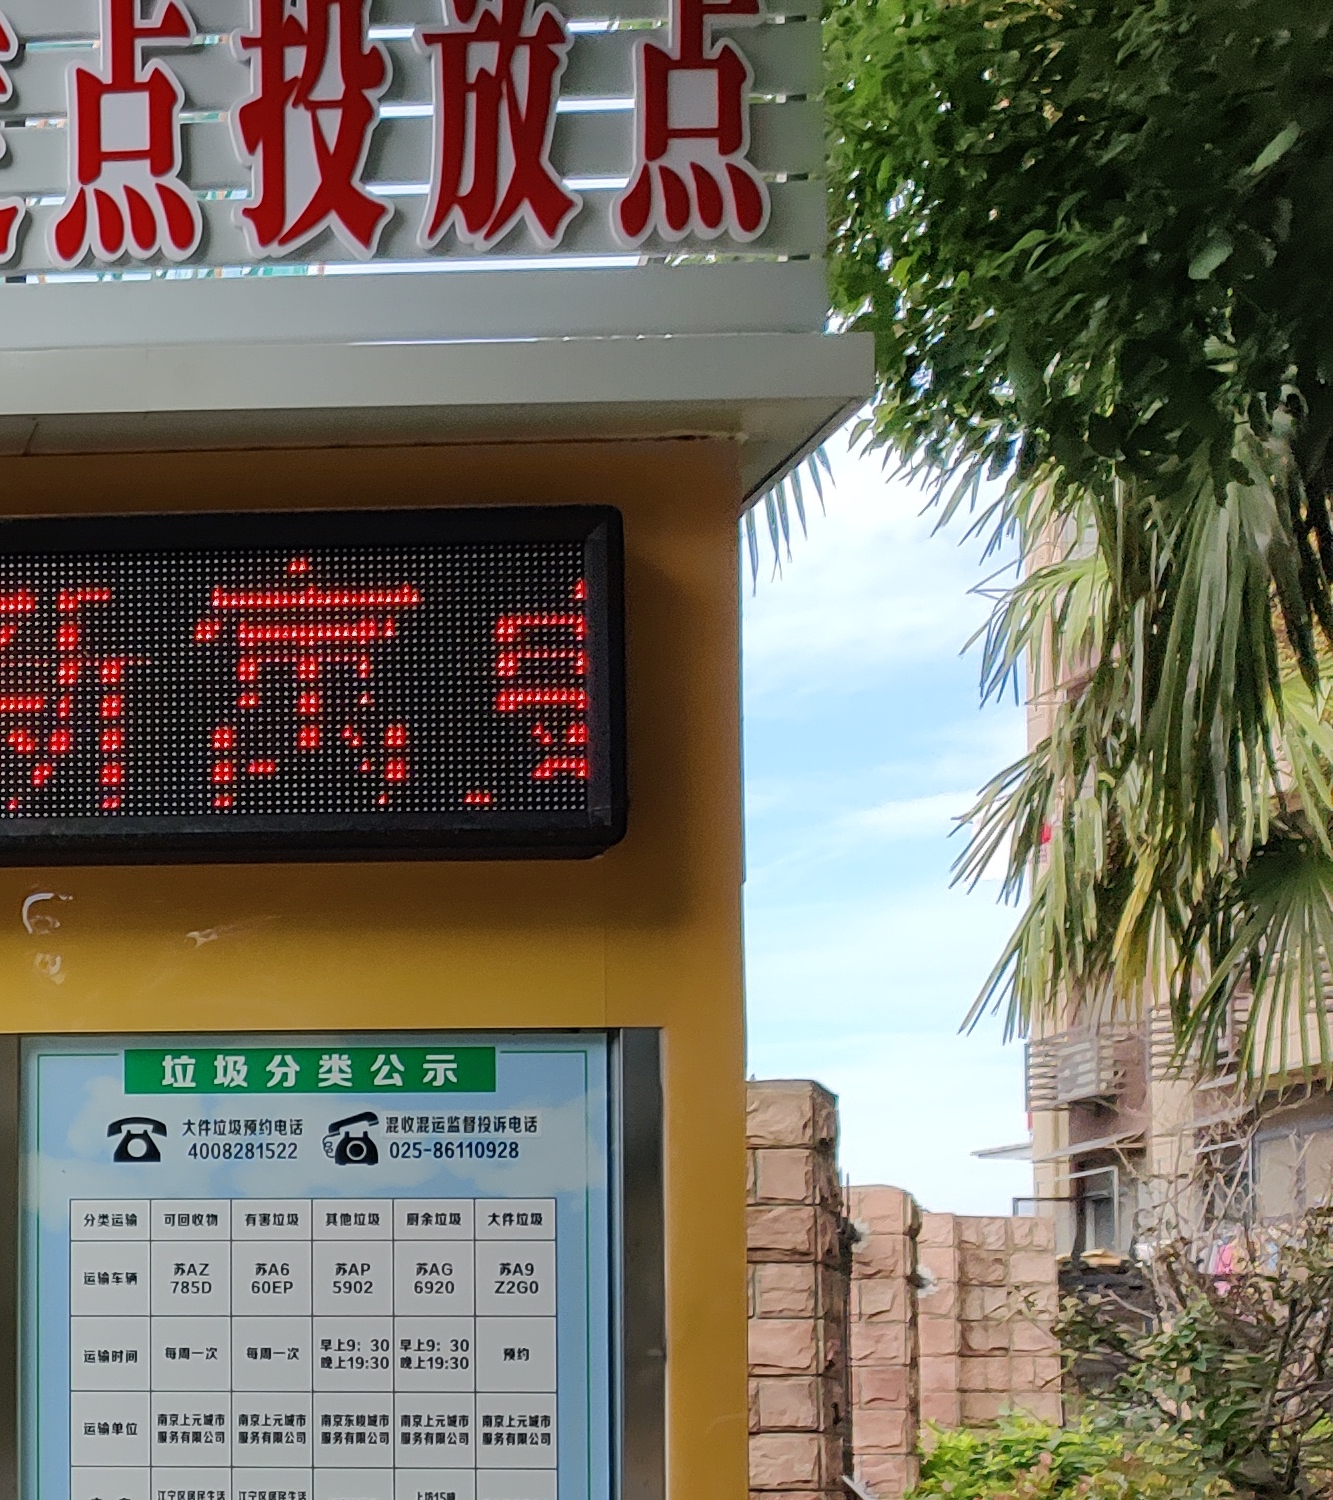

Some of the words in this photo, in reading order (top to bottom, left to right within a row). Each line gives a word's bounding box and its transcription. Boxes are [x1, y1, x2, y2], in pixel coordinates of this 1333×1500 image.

[161, 1053, 459, 1089] 垃圾分类公示
[181, 1118, 304, 1138] 大件垃圾预约电话
[384, 1115, 539, 1135] 混收混运监督投诉电话
[187, 1142, 298, 1161] 4008281522
[388, 1141, 520, 1161] 025-86110928
[83, 1213, 138, 1227] 分类运输
[163, 1213, 219, 1227] 可回收物
[244, 1213, 299, 1227] 有害垃圾
[325, 1213, 380, 1227] 其他垃圾
[406, 1213, 462, 1227] 厨余垃圾
[487, 1213, 543, 1227] 大件垃圾
[173, 1262, 210, 1277] 苏AZ
[255, 1262, 290, 1277] 苏A6
[335, 1262, 371, 1277] 苏AP
[415, 1262, 454, 1277] 苏AG
[499, 1262, 534, 1277] 苏A9
[83, 1271, 138, 1286] 运输车辆
[170, 1280, 212, 1295] 785D
[251, 1280, 294, 1295] 60EP
[332, 1280, 373, 1295] 5902
[414, 1280, 455, 1295] 6920
[494, 1280, 539, 1295] Z2G0
[83, 1350, 138, 1364] 运输时间
[165, 1347, 219, 1361] 每周一次
[246, 1347, 300, 1361] 每周一次
[503, 1347, 530, 1361] 预约
[320, 1357, 390, 1370] 晚上19:30
[399, 1357, 470, 1370] 晚上19:30
[157, 1413, 226, 1428] 南京上元城市
[238, 1413, 307, 1428] 南京上元城市
[400, 1414, 469, 1429] 南京上元城市
[482, 1414, 551, 1429] 南京上元城市
[83, 1422, 138, 1436] 运输单位
[157, 1431, 226, 1445] 服务有限公司
[238, 1431, 307, 1445] 服务有限公司
[321, 1432, 390, 1446] 服务有限公司
[400, 1432, 469, 1446] 服务有限公司
[482, 1432, 551, 1446] 服务有限公司
